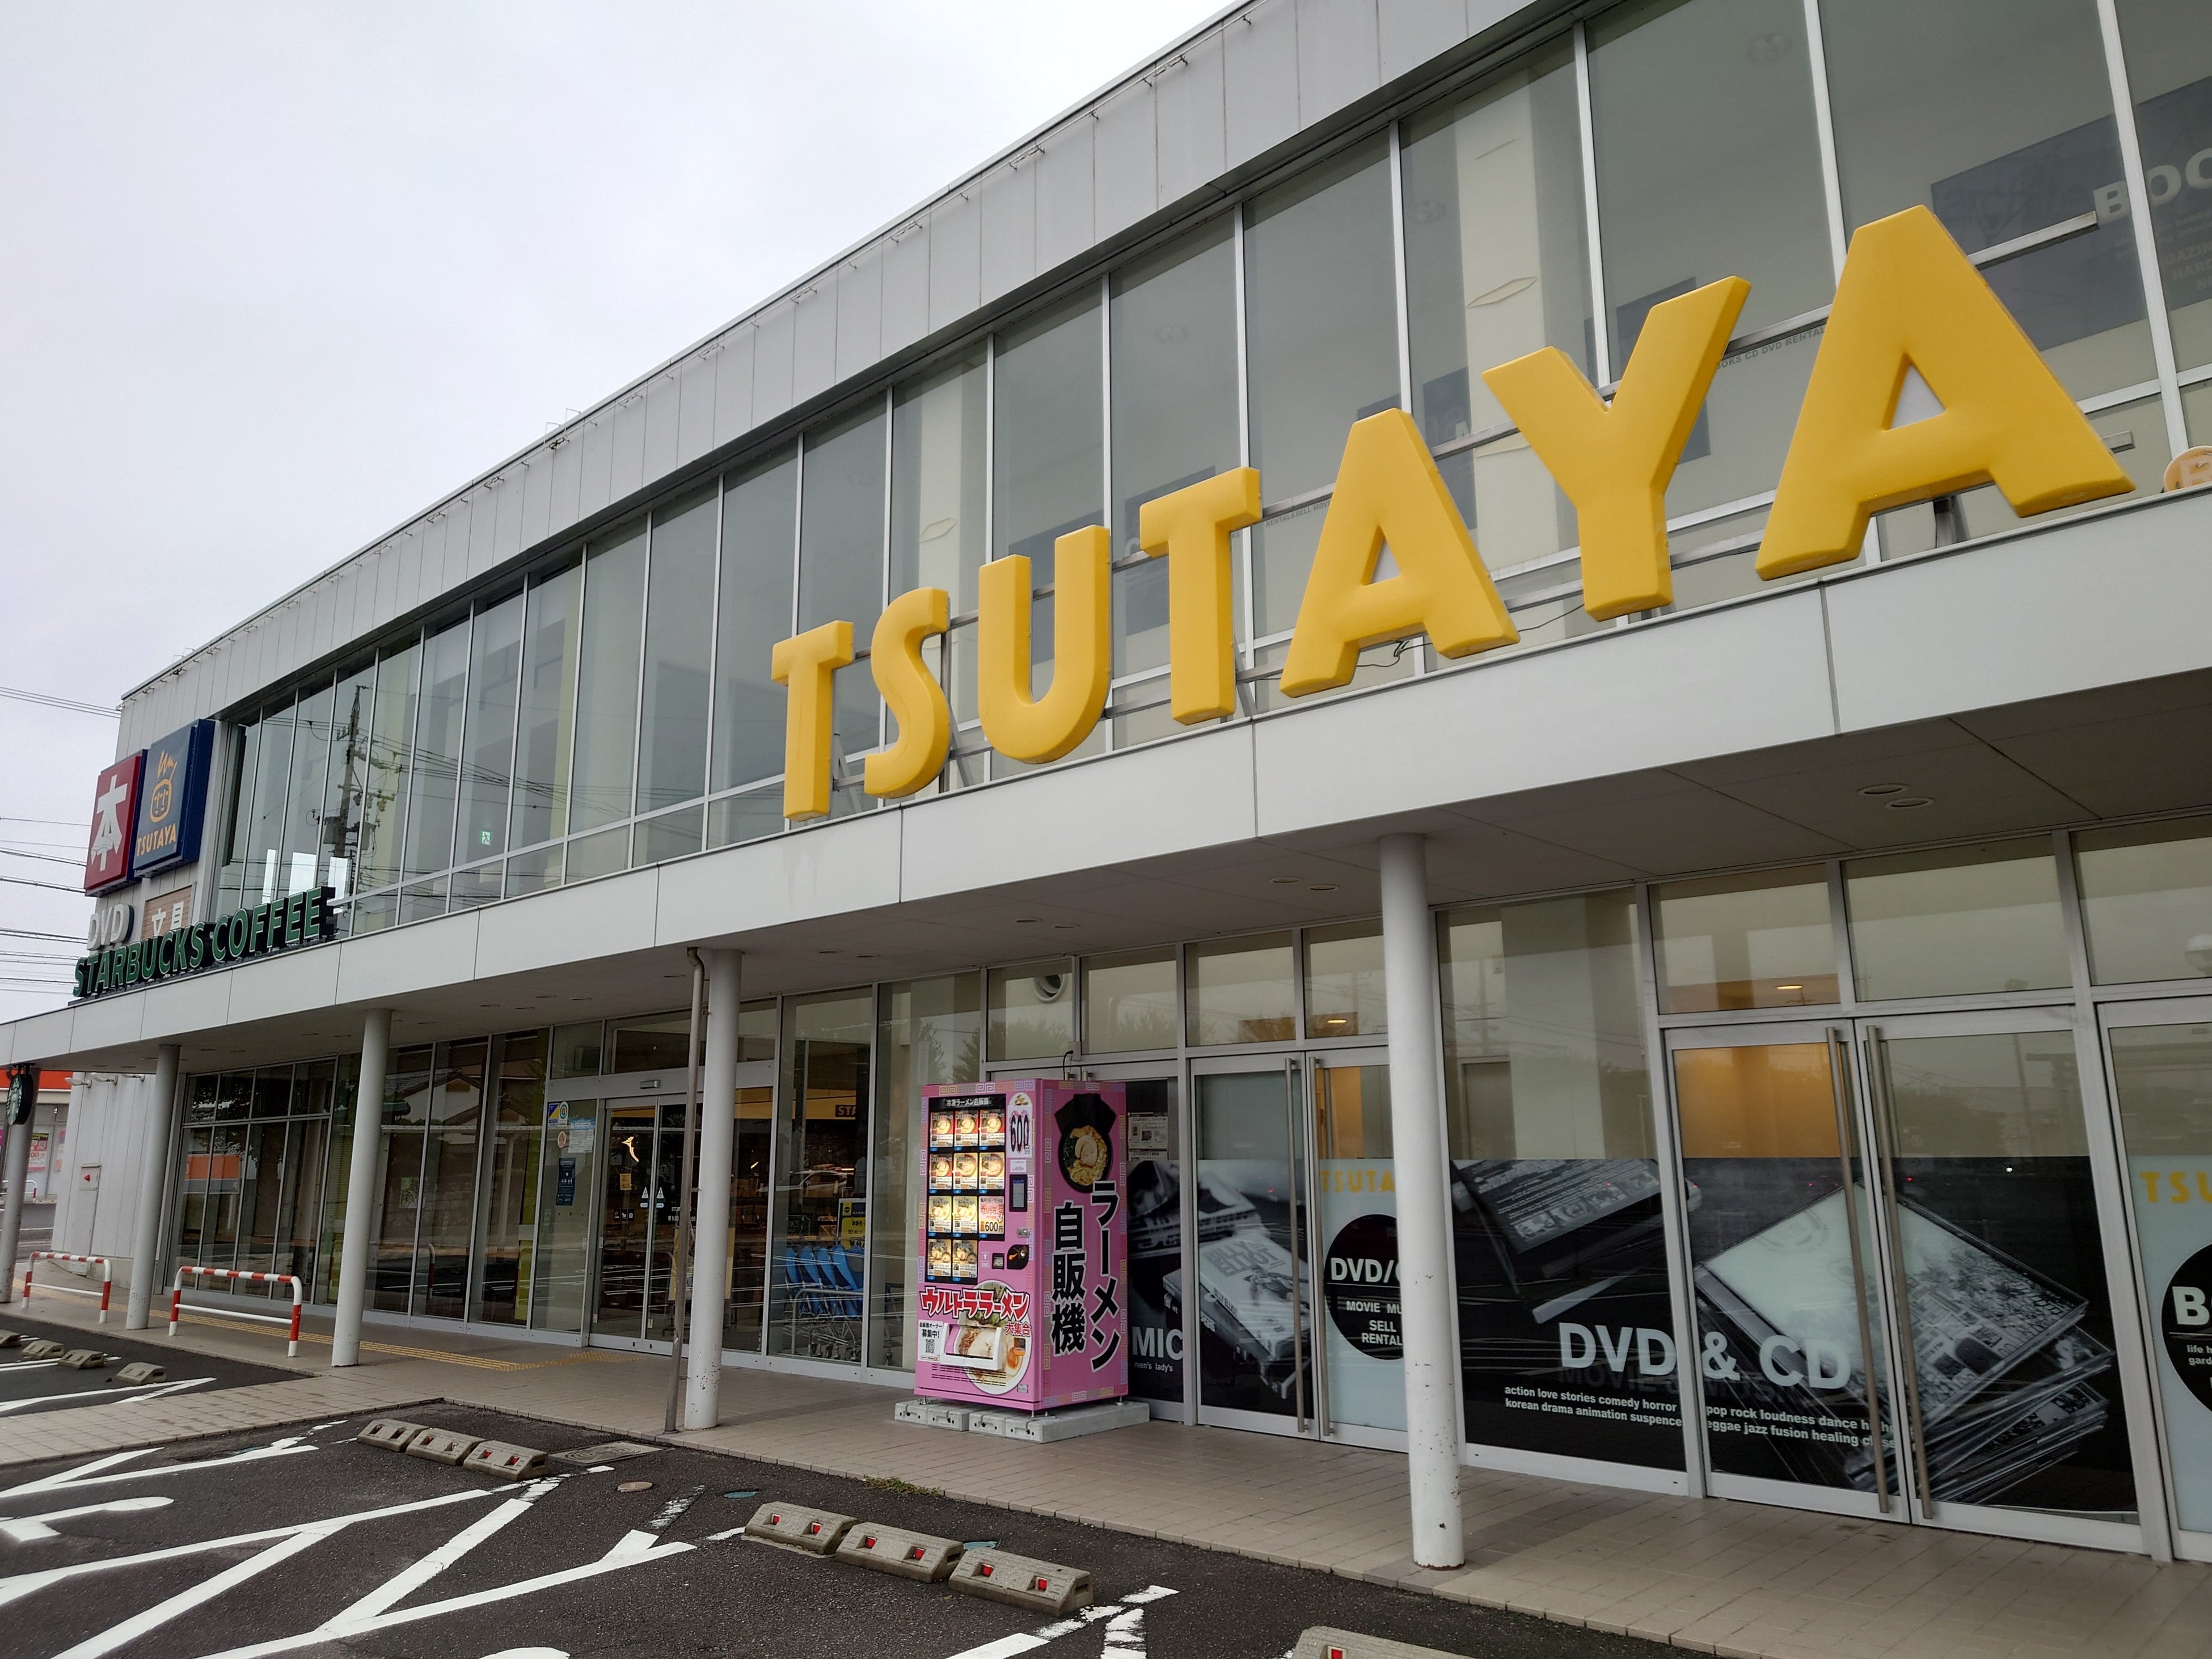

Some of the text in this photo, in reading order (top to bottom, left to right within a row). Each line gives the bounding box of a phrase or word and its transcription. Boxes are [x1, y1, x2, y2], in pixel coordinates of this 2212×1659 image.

[1745, 349, 1758, 360] CD
[1762, 341, 1782, 354] DVD
[1786, 327, 1825, 346] RENTAL
[771, 205, 2135, 822] TSUTAYA
[91, 774, 127, 871] 本
[136, 823, 177, 858] TSUTAYA
[73, 886, 329, 998] STARBUCKS COFFEE
[87, 904, 133, 950] DVD
[1052, 1201, 1086, 1356] 自販機
[1091, 1180, 1121, 1371] ラーメン
[919, 1285, 1031, 1321] ウルトララーメン
[1346, 1301, 1381, 1312] MOVIE
[2172, 1285, 2212, 1325] B
[1005, 1322, 1031, 1337] 大集合
[1362, 1332, 1403, 1346] RENTAL
[1369, 1319, 1397, 1332] SELL
[1559, 1322, 1851, 1390] DVD & CD
[2186, 1343, 2204, 1354] life
[1134, 1361, 1173, 1373] men's lady's
[1504, 1385, 1678, 1412] action love stories comedy horror
[1505, 1398, 1683, 1428] korean drama animation suspence
[1706, 1405, 1727, 1419] pop
[1730, 1407, 1758, 1419] rock
[1759, 1409, 1816, 1425] loudness
[1818, 1416, 1858, 1430] dance
[1744, 1422, 1768, 1436] jazz
[1770, 1426, 1809, 1440] fusion
[1812, 1432, 1859, 1447] healing
